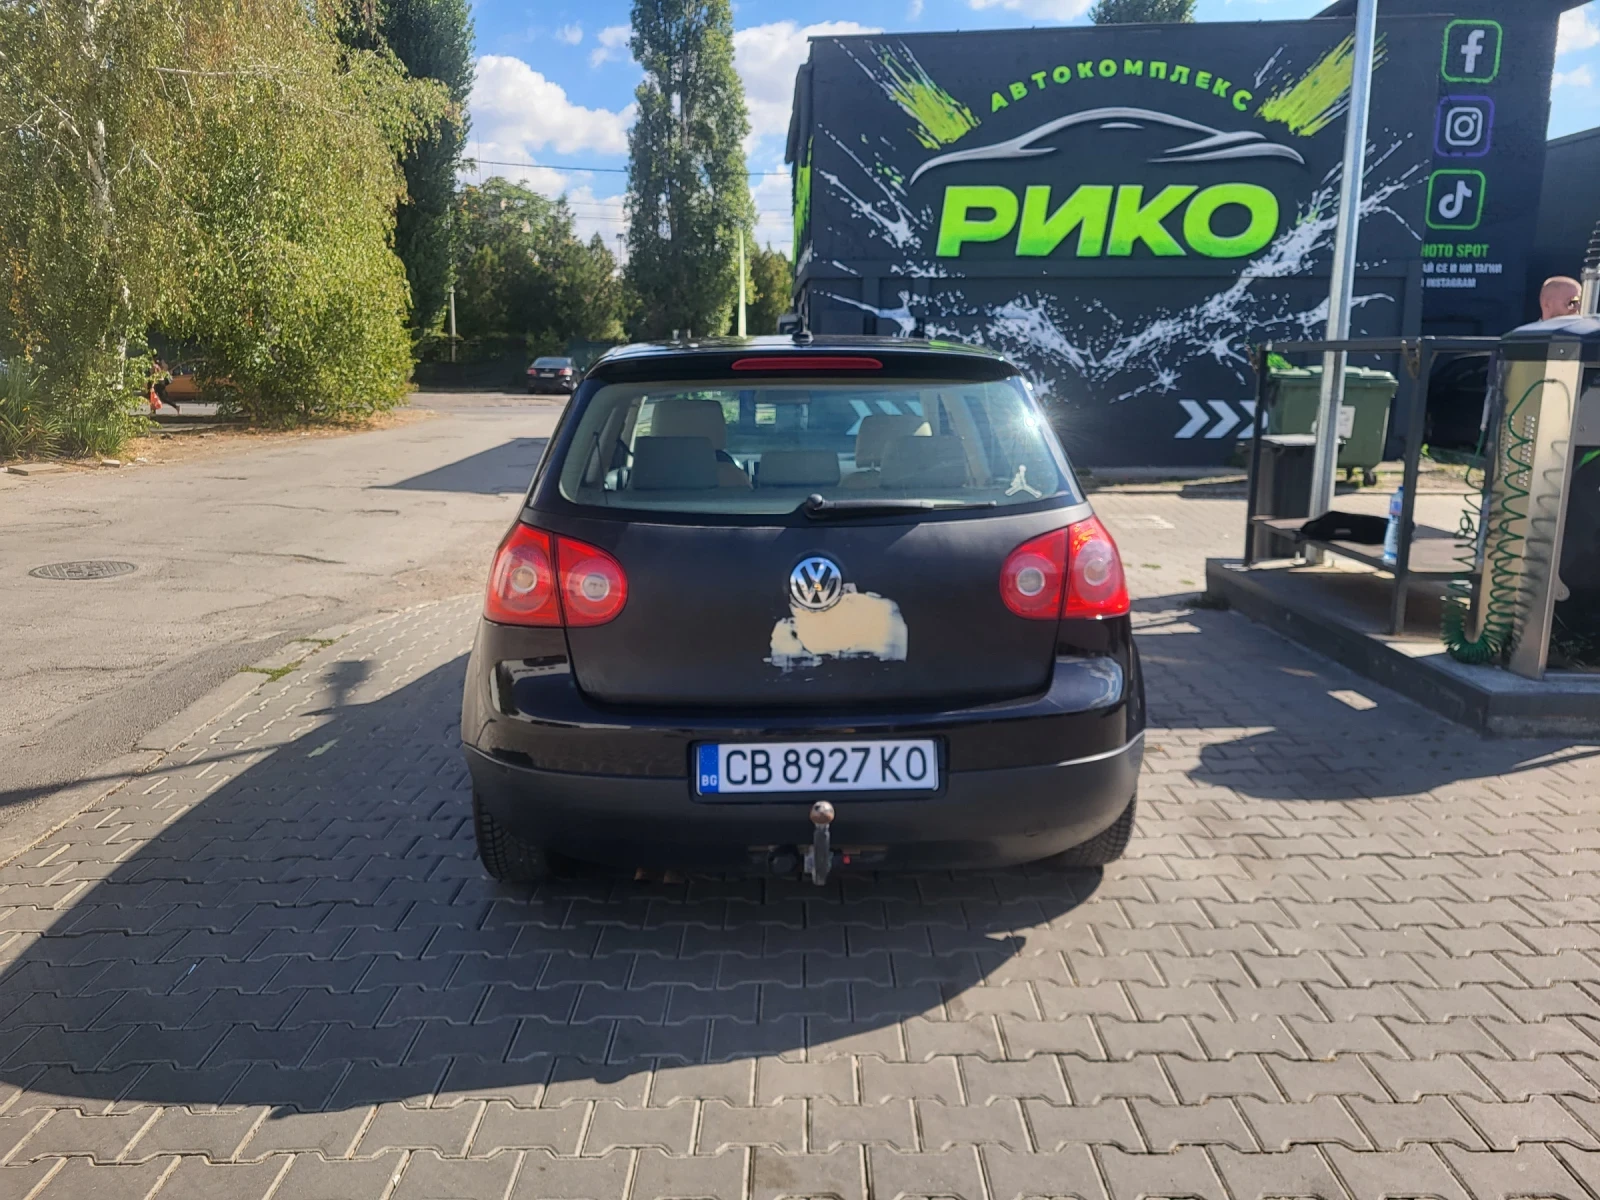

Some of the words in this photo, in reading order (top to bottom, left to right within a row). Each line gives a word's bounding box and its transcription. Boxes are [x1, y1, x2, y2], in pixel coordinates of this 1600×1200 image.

[991, 59, 1253, 113] АВТОКОМПЛЕКС
[935, 182, 1279, 258] РИКО
[1421, 243, 1453, 258] HOTO
[1456, 243, 1489, 258] SPOT
[1426, 277, 1476, 288] INSTAGRAM
[726, 749, 772, 785] CB
[782, 746, 871, 784] 8927
[880, 745, 927, 782] KO
[701, 774, 718, 787] BG
